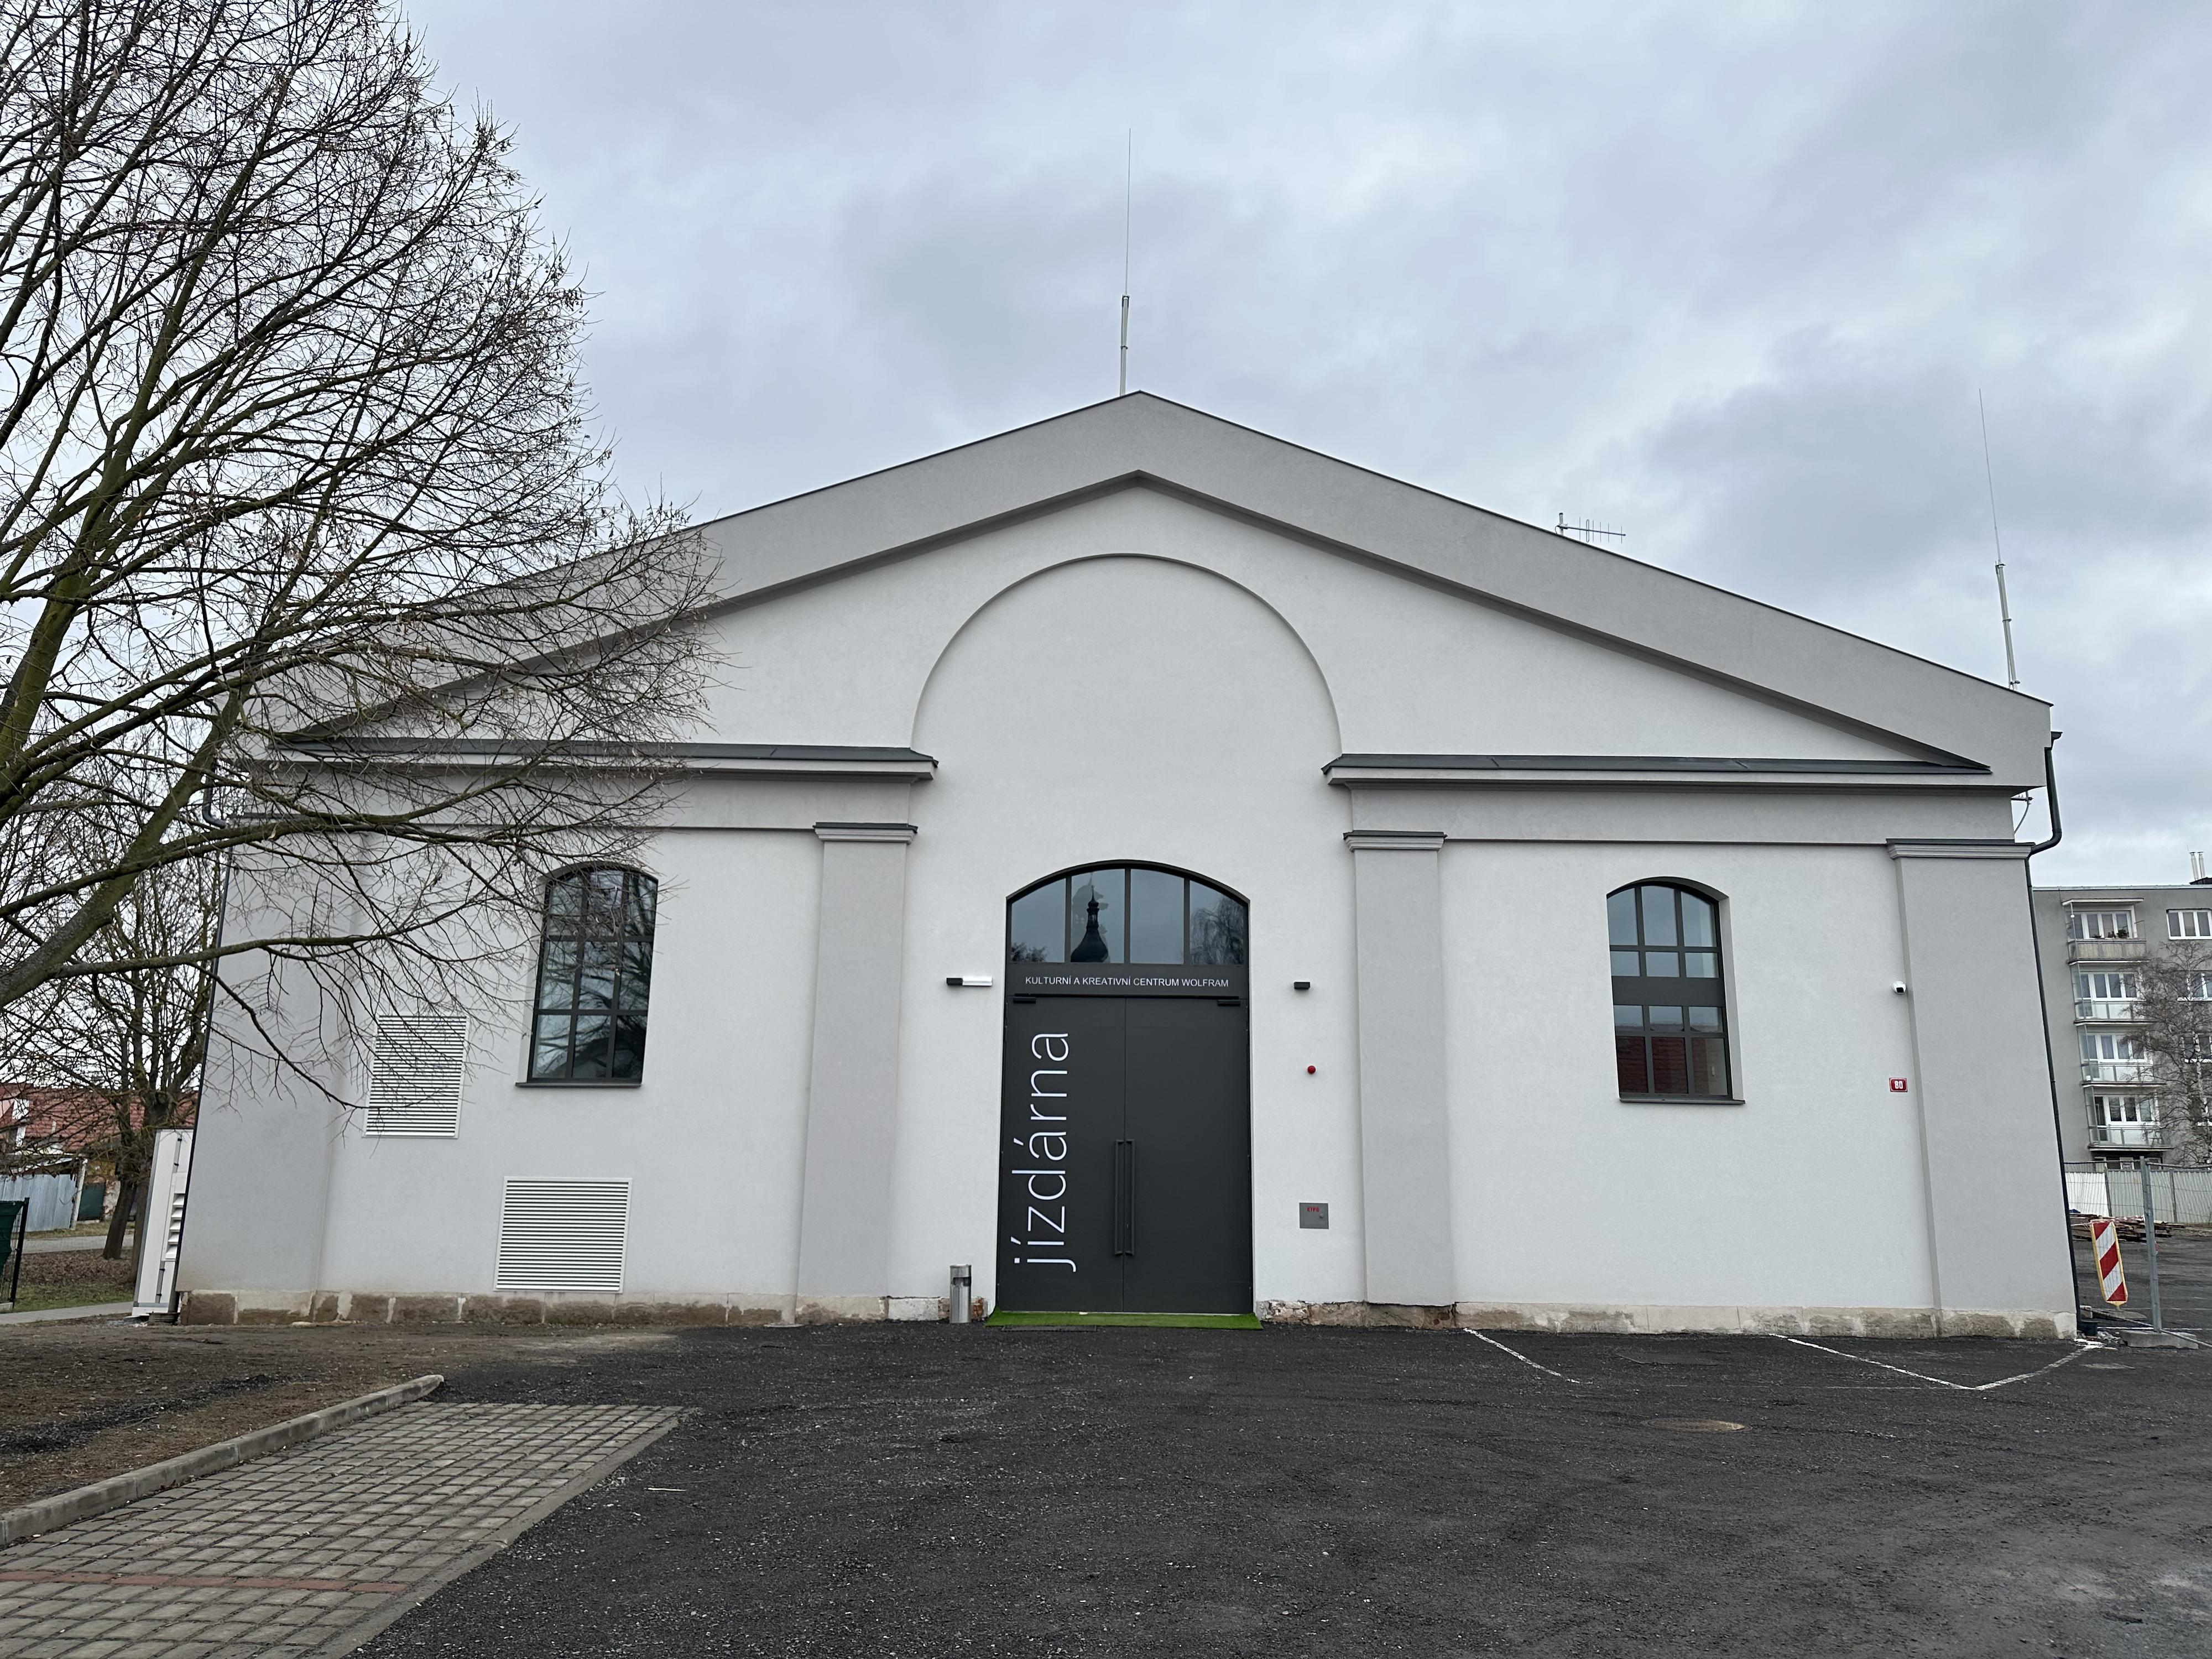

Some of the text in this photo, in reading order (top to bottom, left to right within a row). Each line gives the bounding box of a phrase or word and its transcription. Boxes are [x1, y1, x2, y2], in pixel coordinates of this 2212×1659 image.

[1025, 975, 1072, 985] KULTURNÍ
[1082, 975, 1131, 985] KREATIVNÍ
[1133, 978, 1180, 987] CENTRUM
[1181, 978, 1229, 987] WOLFRAM
[1894, 1081, 1903, 1089] 80
[1010, 1032, 1076, 1272] jízdárna
